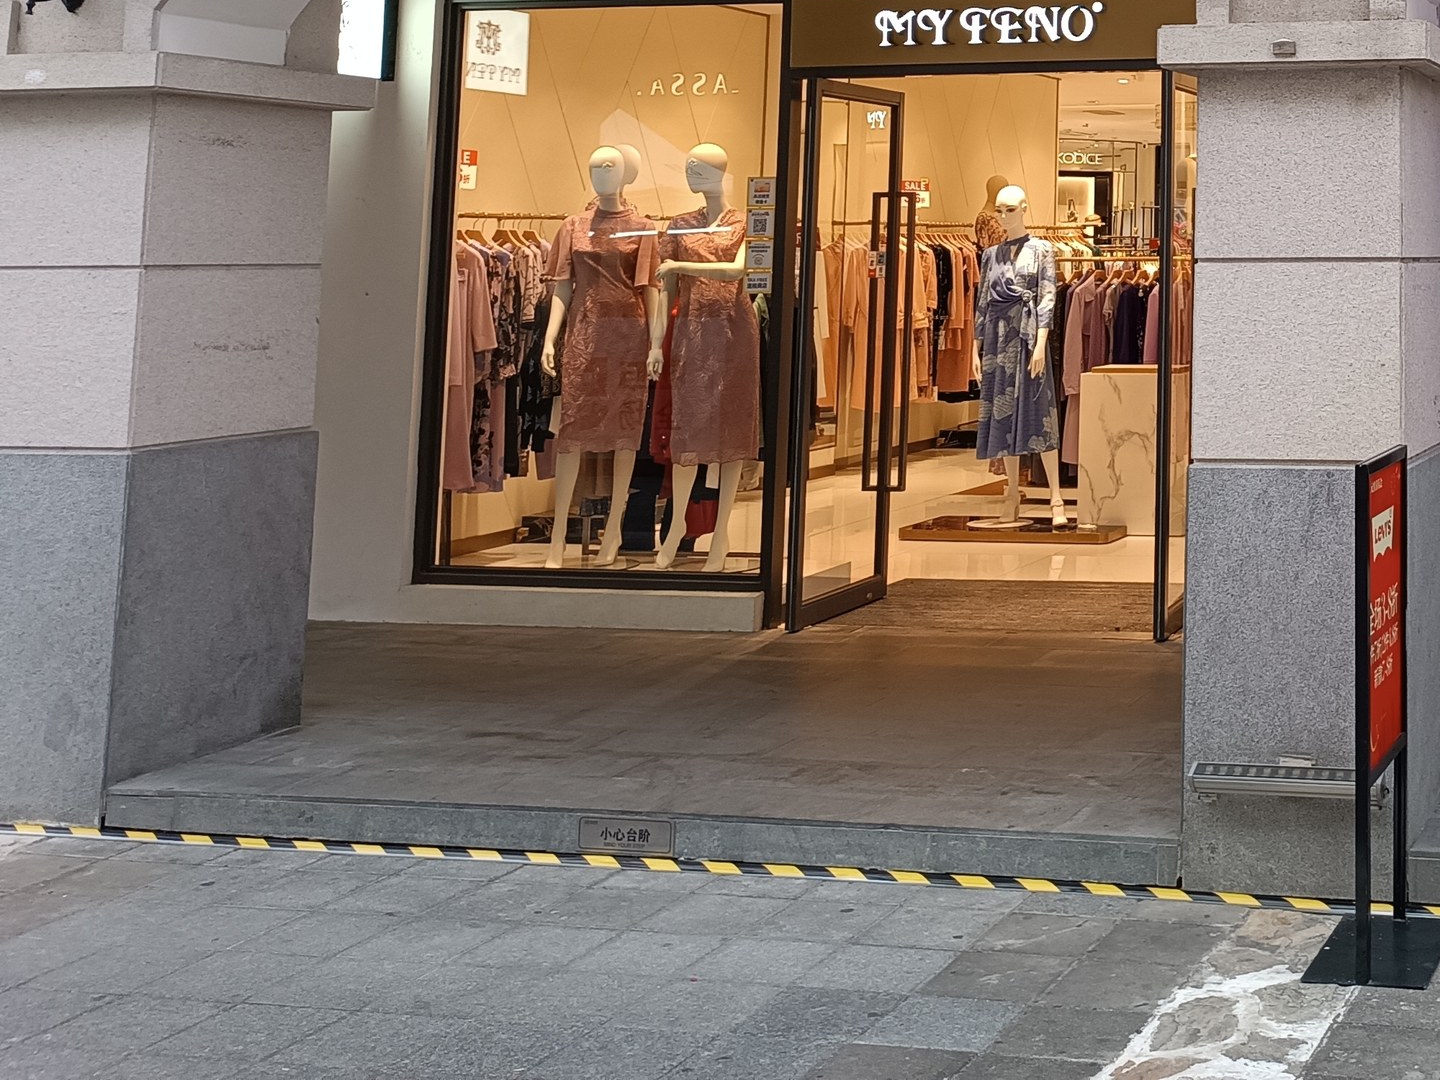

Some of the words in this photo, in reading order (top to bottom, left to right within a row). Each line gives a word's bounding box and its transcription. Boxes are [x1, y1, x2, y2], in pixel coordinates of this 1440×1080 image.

[875, 8, 953, 47] MY
[961, 3, 1094, 45] FENO
[904, 181, 927, 191] SALE
[600, 826, 651, 843] 小心台阶
